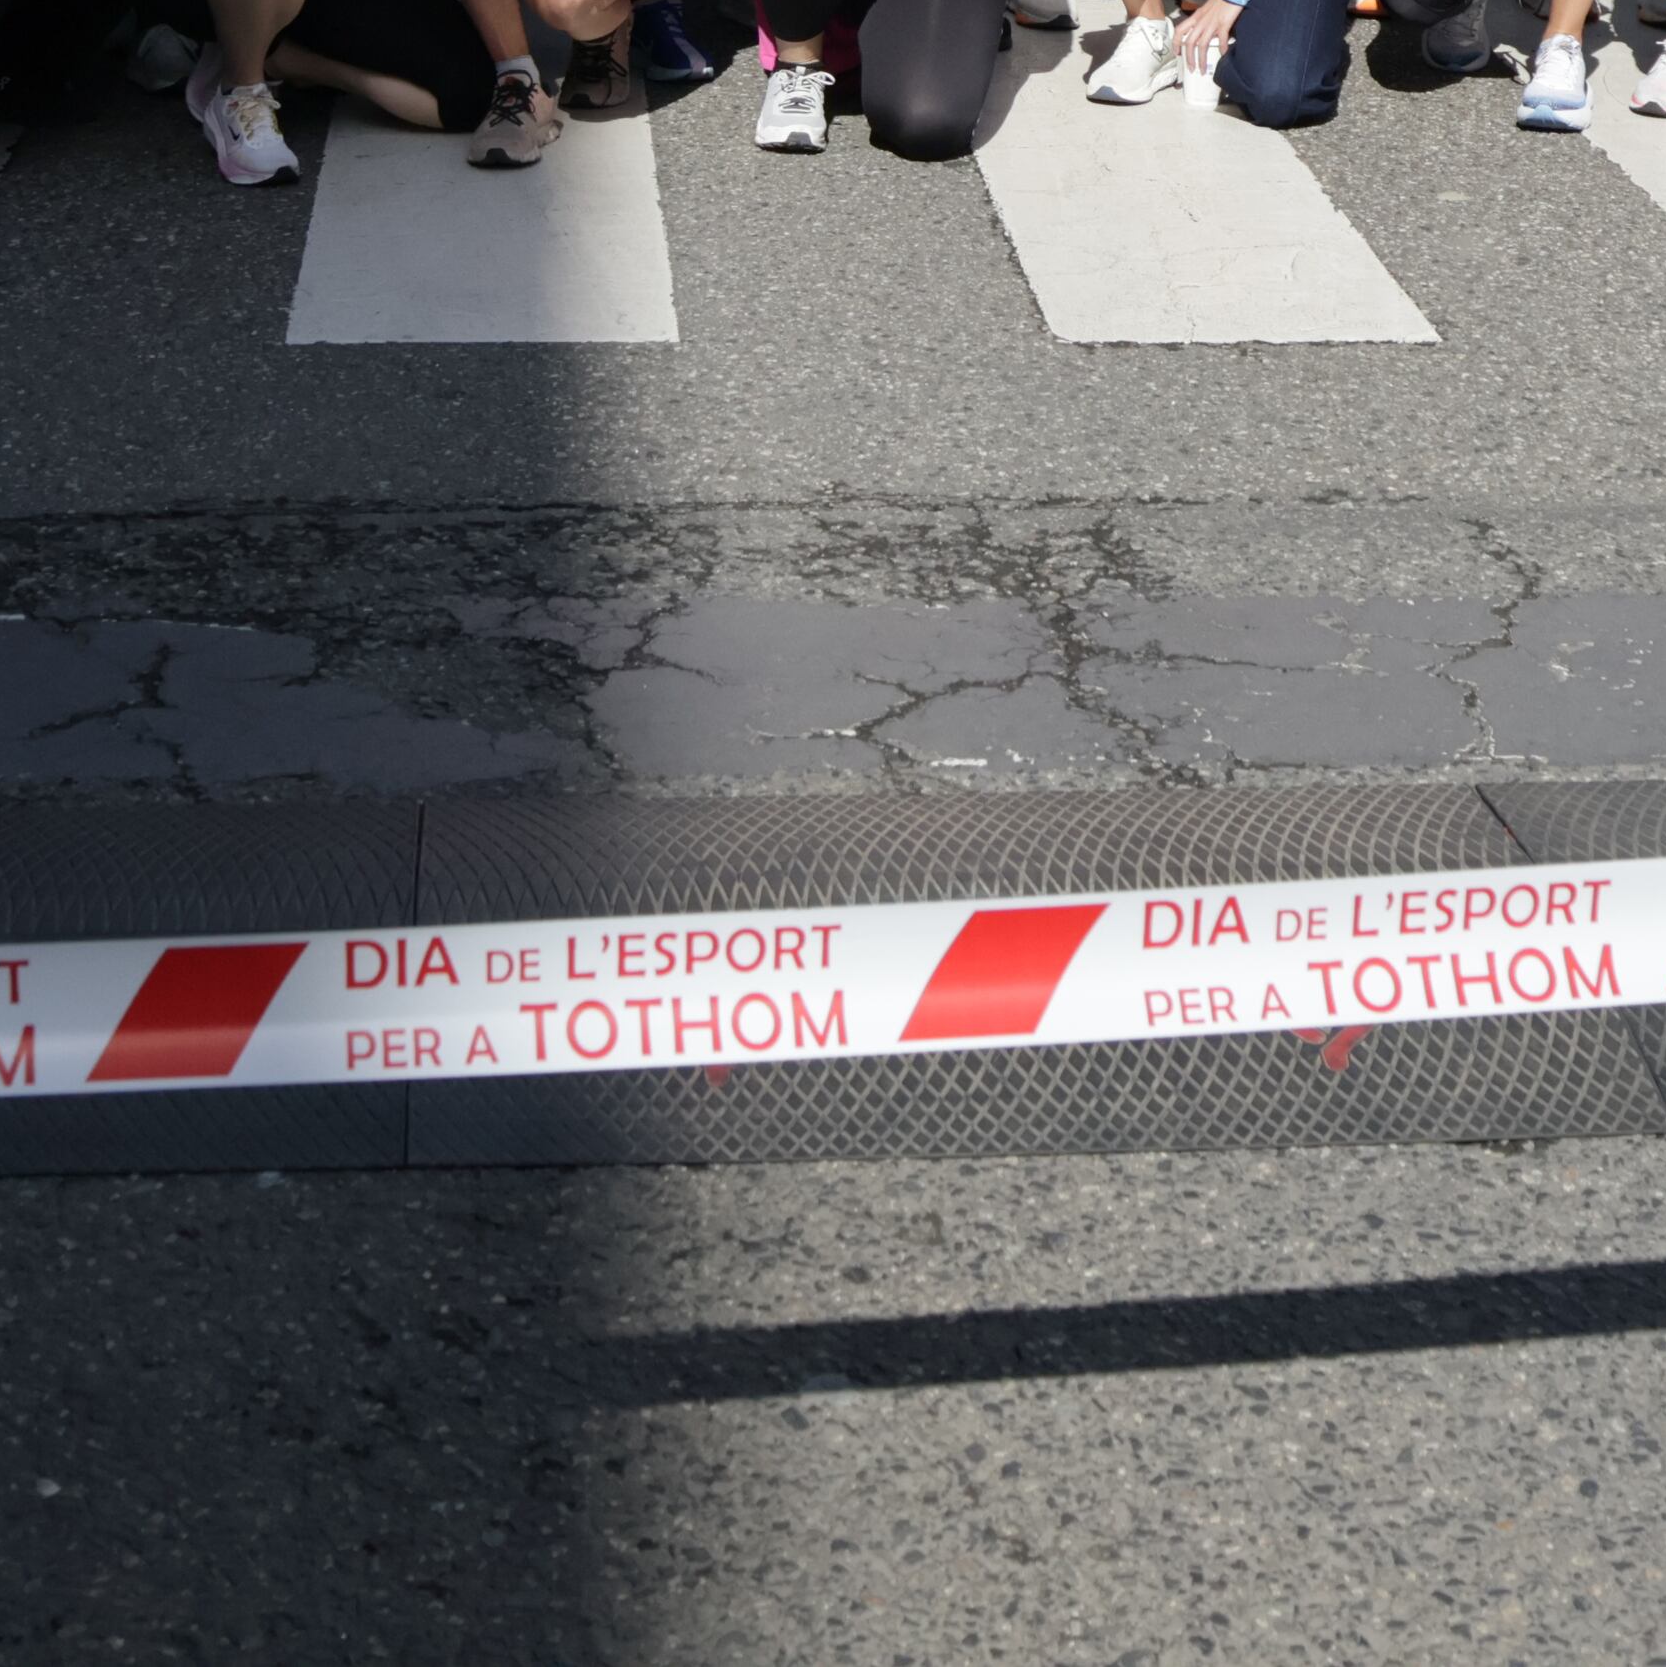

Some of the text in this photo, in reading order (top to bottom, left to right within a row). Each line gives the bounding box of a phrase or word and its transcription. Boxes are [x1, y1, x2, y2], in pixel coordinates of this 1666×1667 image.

[1143, 880, 1611, 949] DIA DE L'ESPORT
[345, 925, 840, 990] DIA DE L'ESPORT
[1145, 939, 1621, 1025] PER A TOTHOM
[348, 990, 847, 1069] PER A TOTHOM
